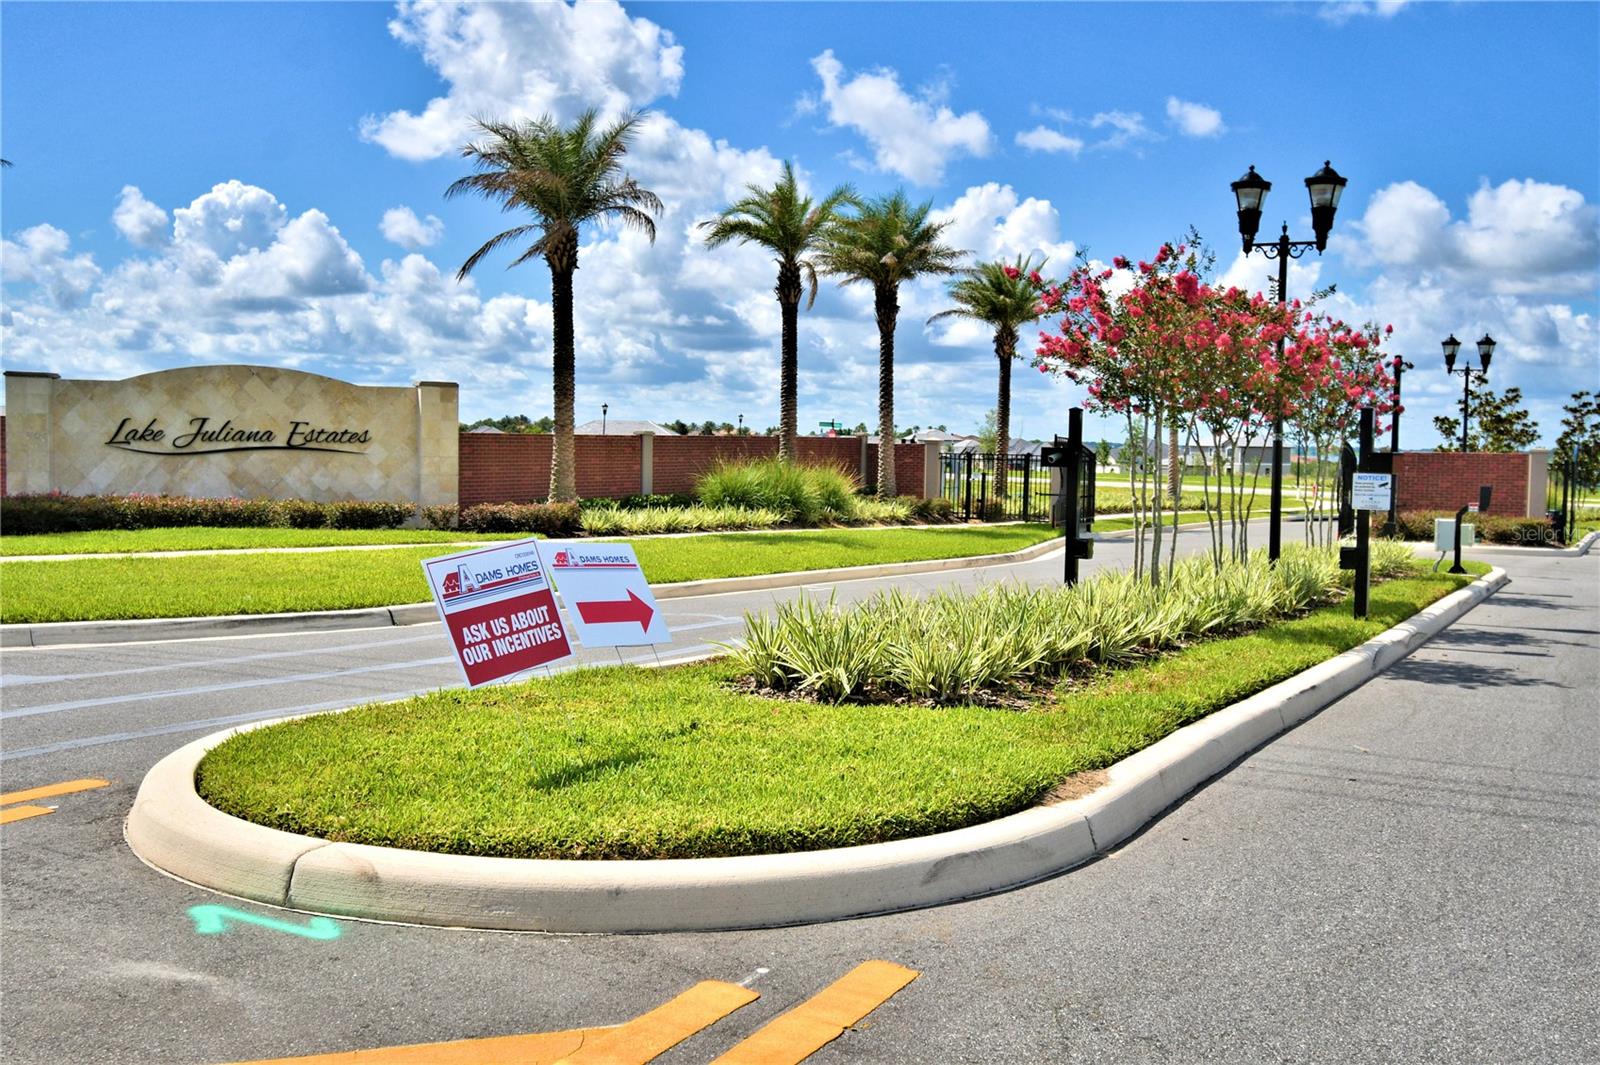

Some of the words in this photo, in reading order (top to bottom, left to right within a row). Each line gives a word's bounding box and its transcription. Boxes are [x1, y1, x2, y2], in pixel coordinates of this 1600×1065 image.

[104, 418, 165, 445] Lake
[172, 417, 275, 448] Juliana
[287, 421, 372, 447] Estates
[602, 555, 630, 563] HOMES
[457, 563, 503, 594] ADAMS
[505, 560, 539, 577] HOMES
[462, 622, 491, 645] ASK
[490, 617, 510, 637] US
[510, 605, 549, 631] ABOUT
[462, 643, 493, 666] OUR
[492, 622, 562, 657] INCENTIVES
